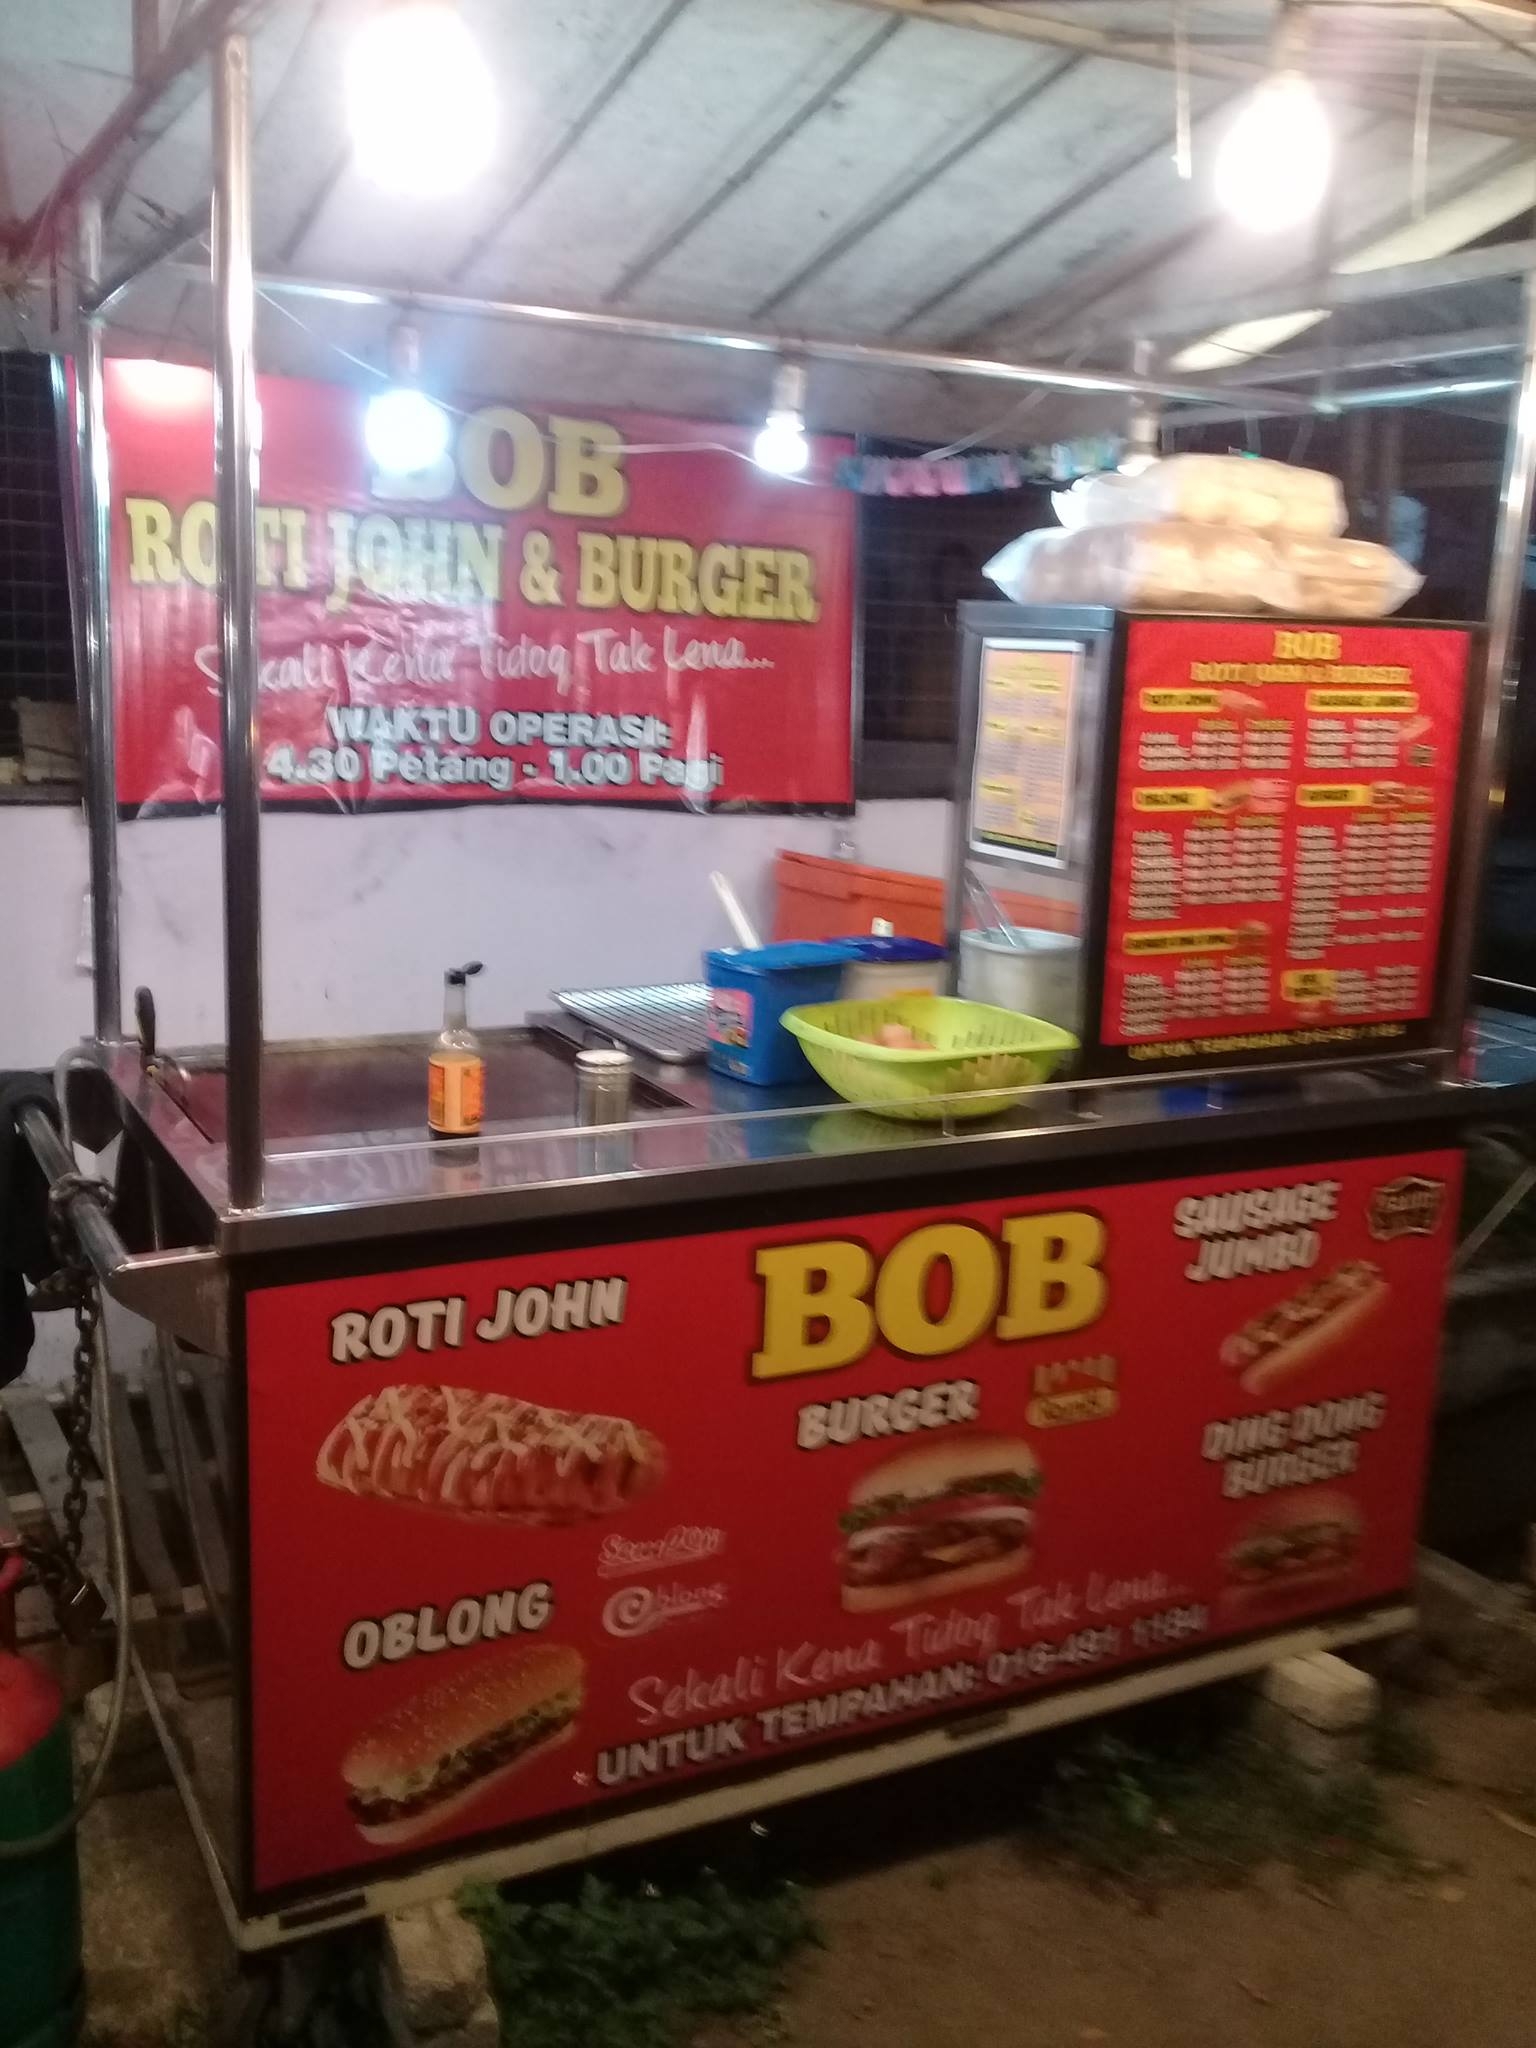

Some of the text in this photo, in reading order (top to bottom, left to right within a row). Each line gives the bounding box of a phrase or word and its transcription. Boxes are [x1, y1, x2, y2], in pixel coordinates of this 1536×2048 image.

[328, 507, 506, 612] JOHN
[519, 529, 565, 607] &
[577, 531, 822, 623] BURGER
[576, 627, 657, 675] Tak
[326, 705, 479, 745] WAKTU
[266, 745, 362, 784] 4.30
[370, 746, 514, 792] Petang
[549, 750, 633, 786] 1.00
[638, 750, 724, 792] Pagi
[330, 1276, 629, 1363] ROTI JOHN
[750, 1210, 1108, 1380] BOB
[798, 1380, 980, 1450] BURGER
[343, 1581, 554, 1670] OBLONG
[627, 1650, 770, 1727] Sekali
[777, 1640, 884, 1692] Kena
[597, 1717, 746, 1786] UNTUK
